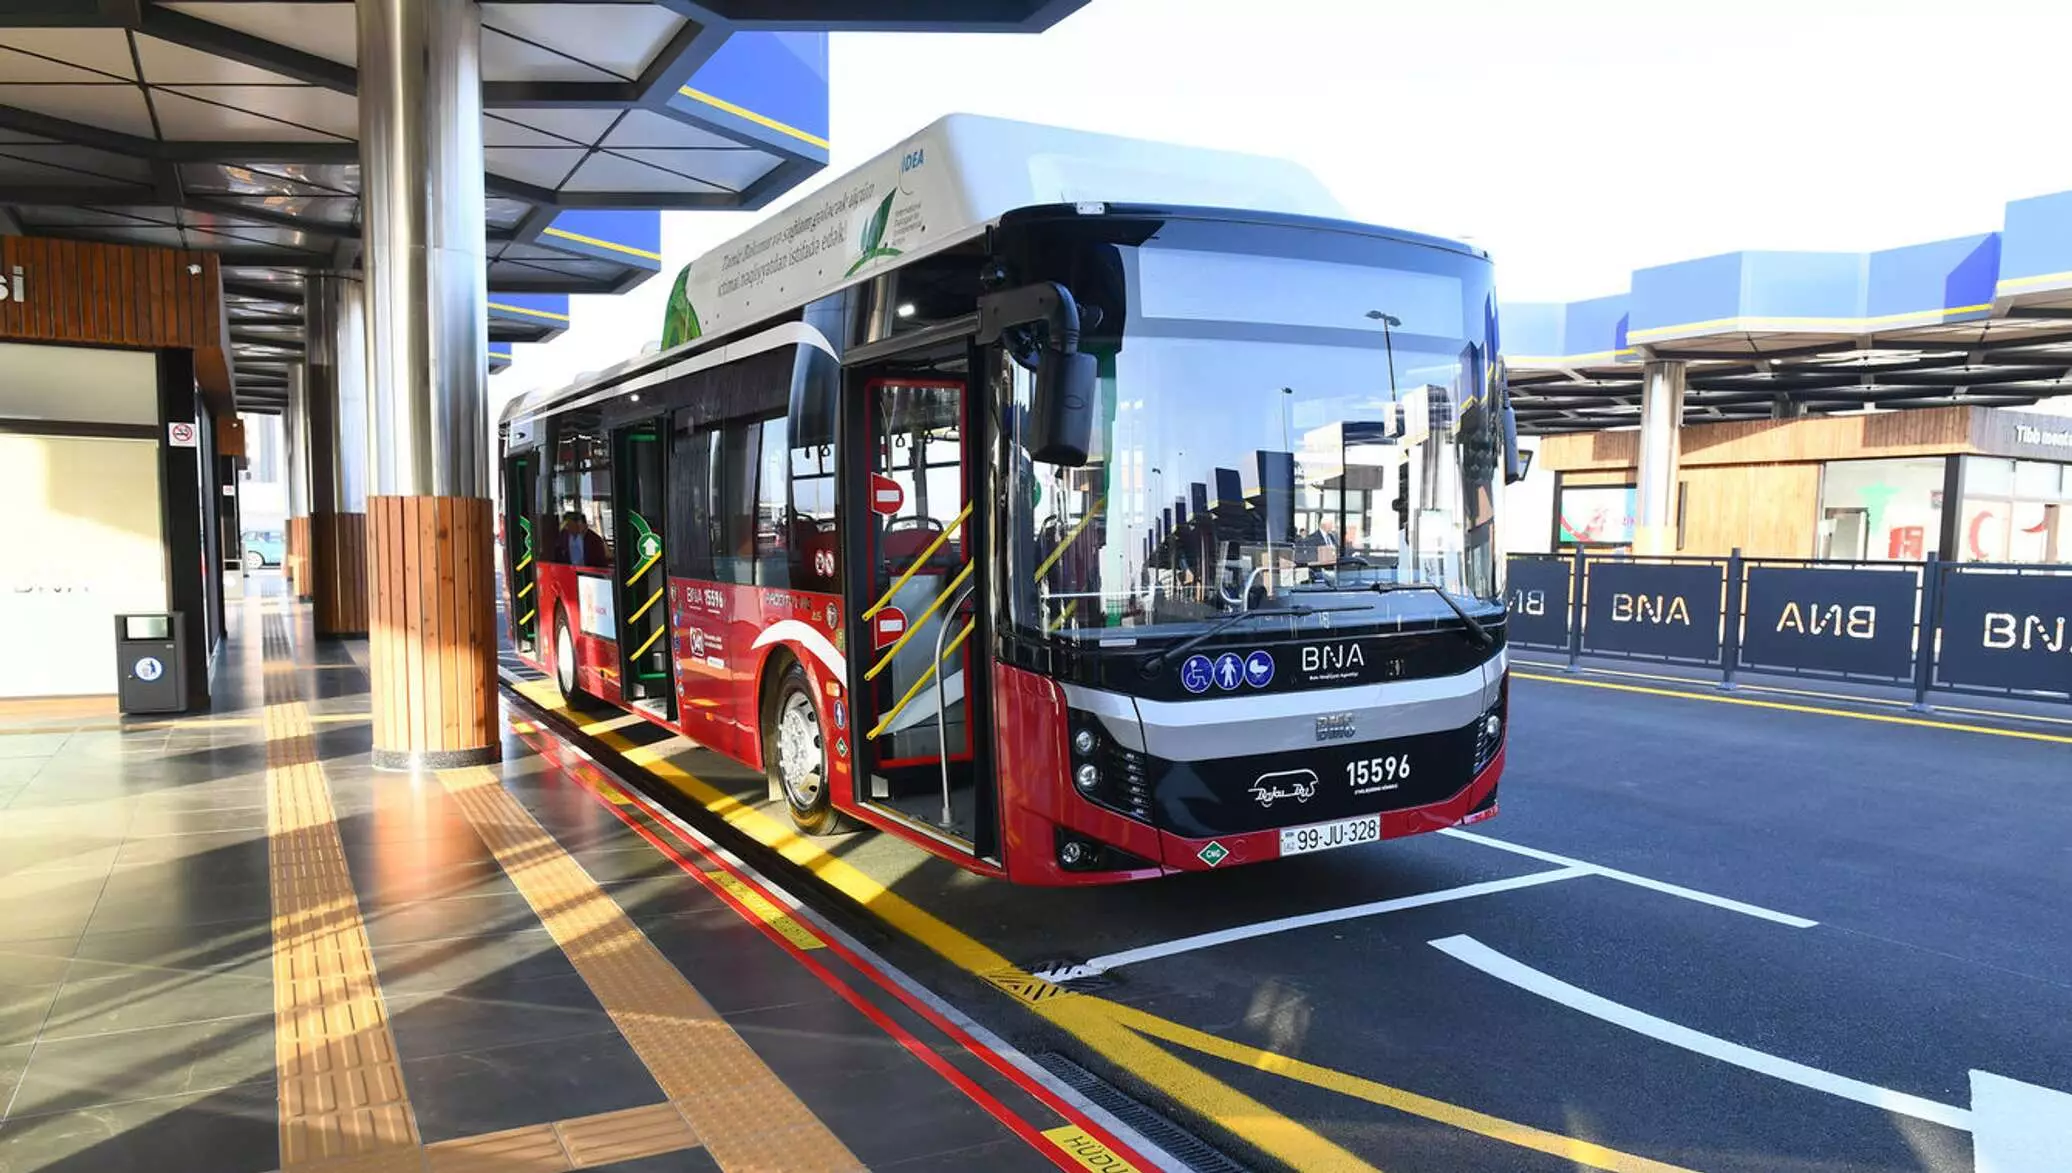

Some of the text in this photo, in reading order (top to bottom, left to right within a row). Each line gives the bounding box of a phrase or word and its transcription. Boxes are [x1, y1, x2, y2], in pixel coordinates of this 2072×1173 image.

[902, 149, 924, 174] IDEA
[2016, 424, 2040, 445] Tibb
[1612, 593, 1690, 625] BNA
[1983, 612, 2072, 652] BN
[1302, 643, 1364, 671] BNA
[1346, 754, 1410, 786] 15596
[1298, 819, 1376, 850] 99-JU-328
